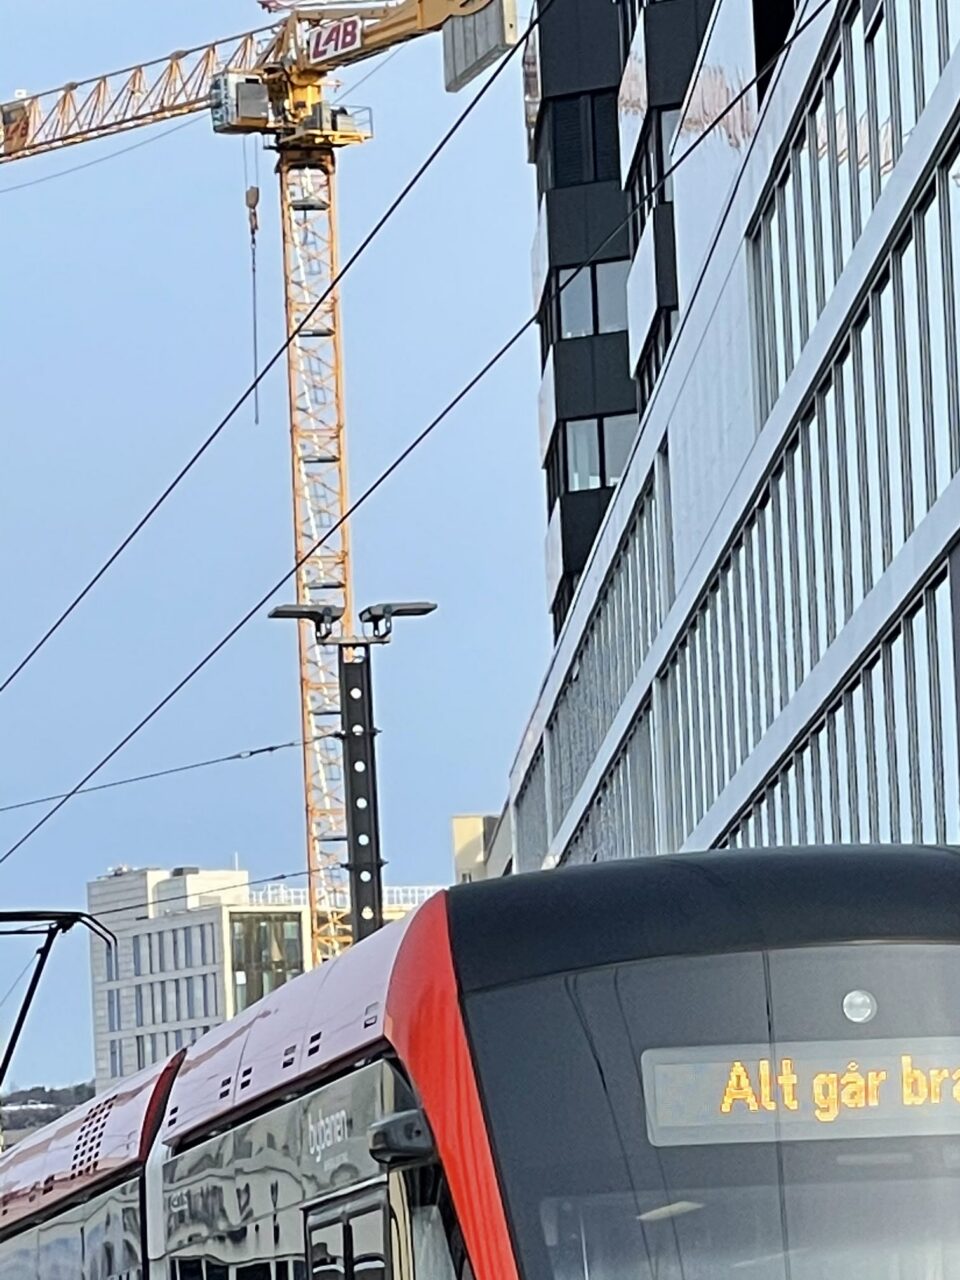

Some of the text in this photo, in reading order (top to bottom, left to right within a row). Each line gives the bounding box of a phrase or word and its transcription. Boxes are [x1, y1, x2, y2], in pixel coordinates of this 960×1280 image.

[312, 20, 358, 59] LAB
[720, 1058, 798, 1113] Alt
[812, 1061, 887, 1122] går
